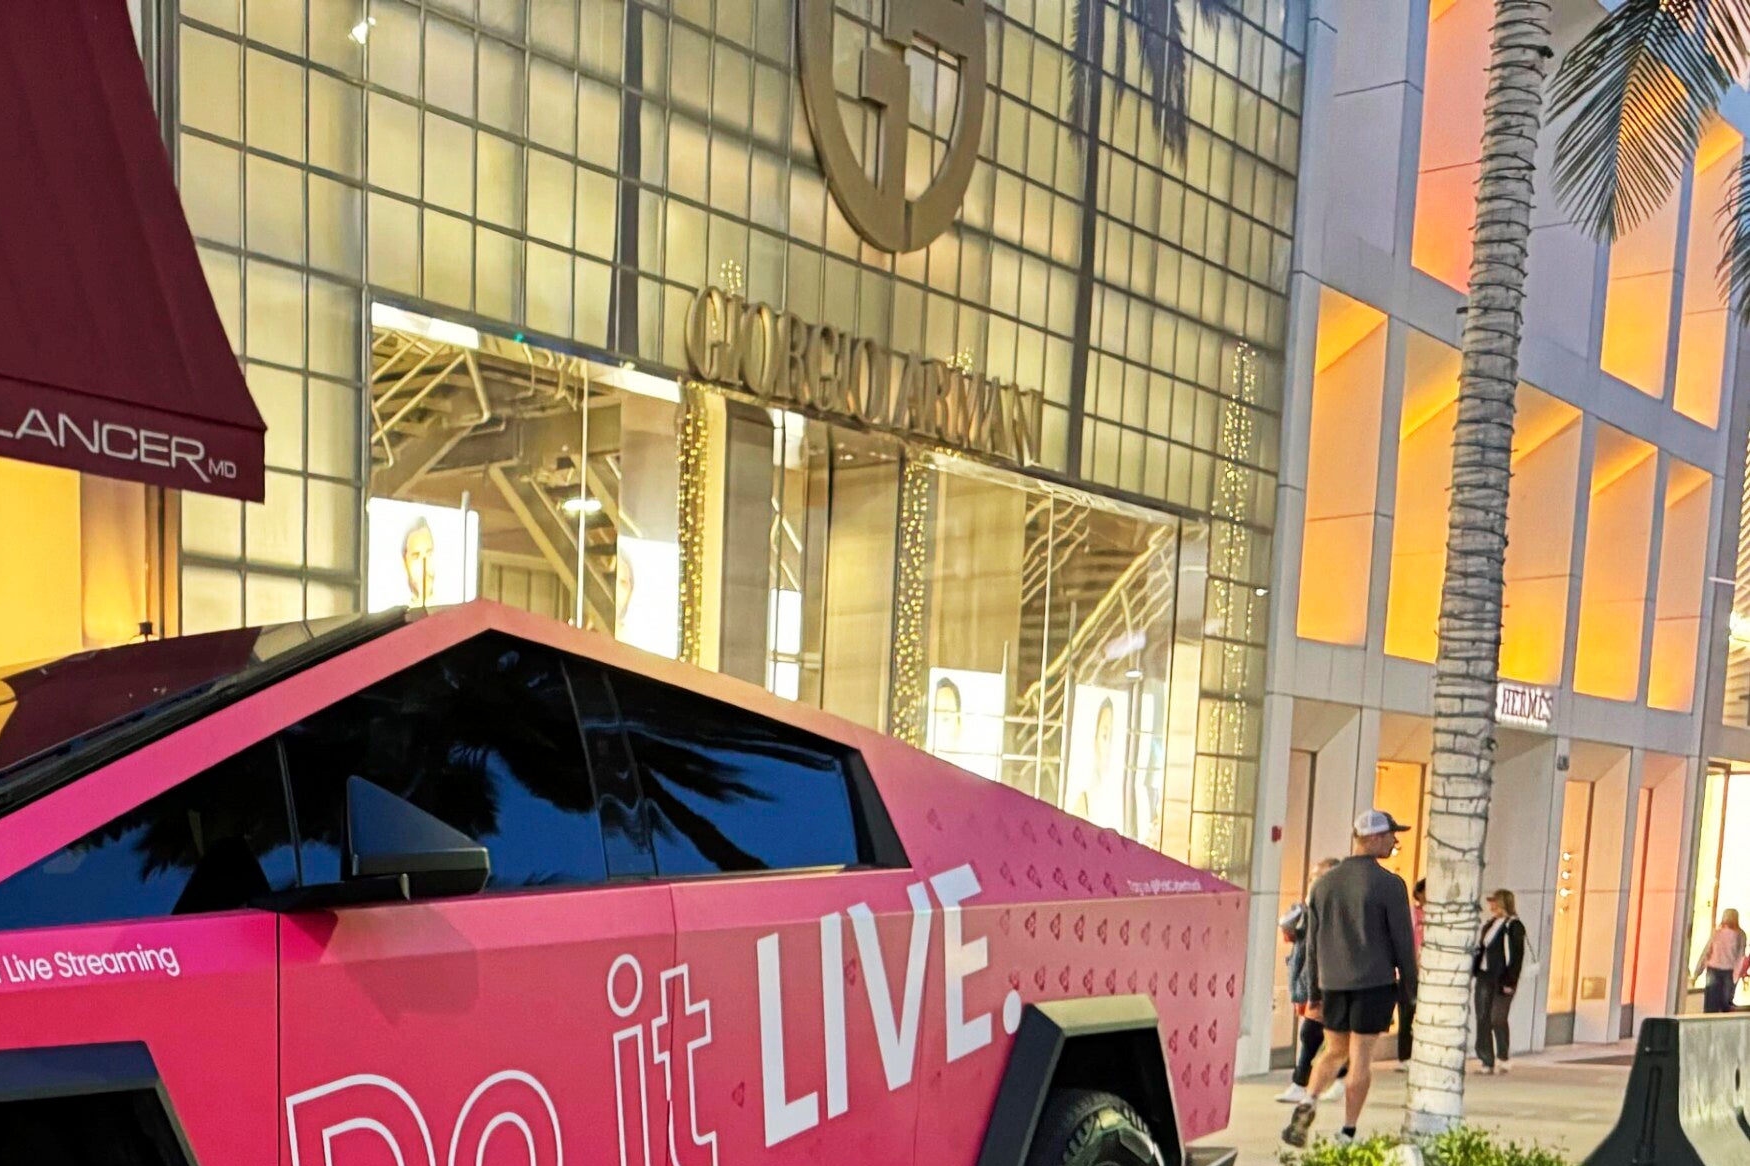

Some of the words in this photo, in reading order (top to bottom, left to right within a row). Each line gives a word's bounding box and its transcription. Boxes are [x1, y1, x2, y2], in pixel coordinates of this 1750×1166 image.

[685, 286, 890, 424] GIORGIO
[3, 952, 53, 984] Live
[55, 943, 181, 977] Streaming
[756, 863, 1022, 1148] LIVE.
